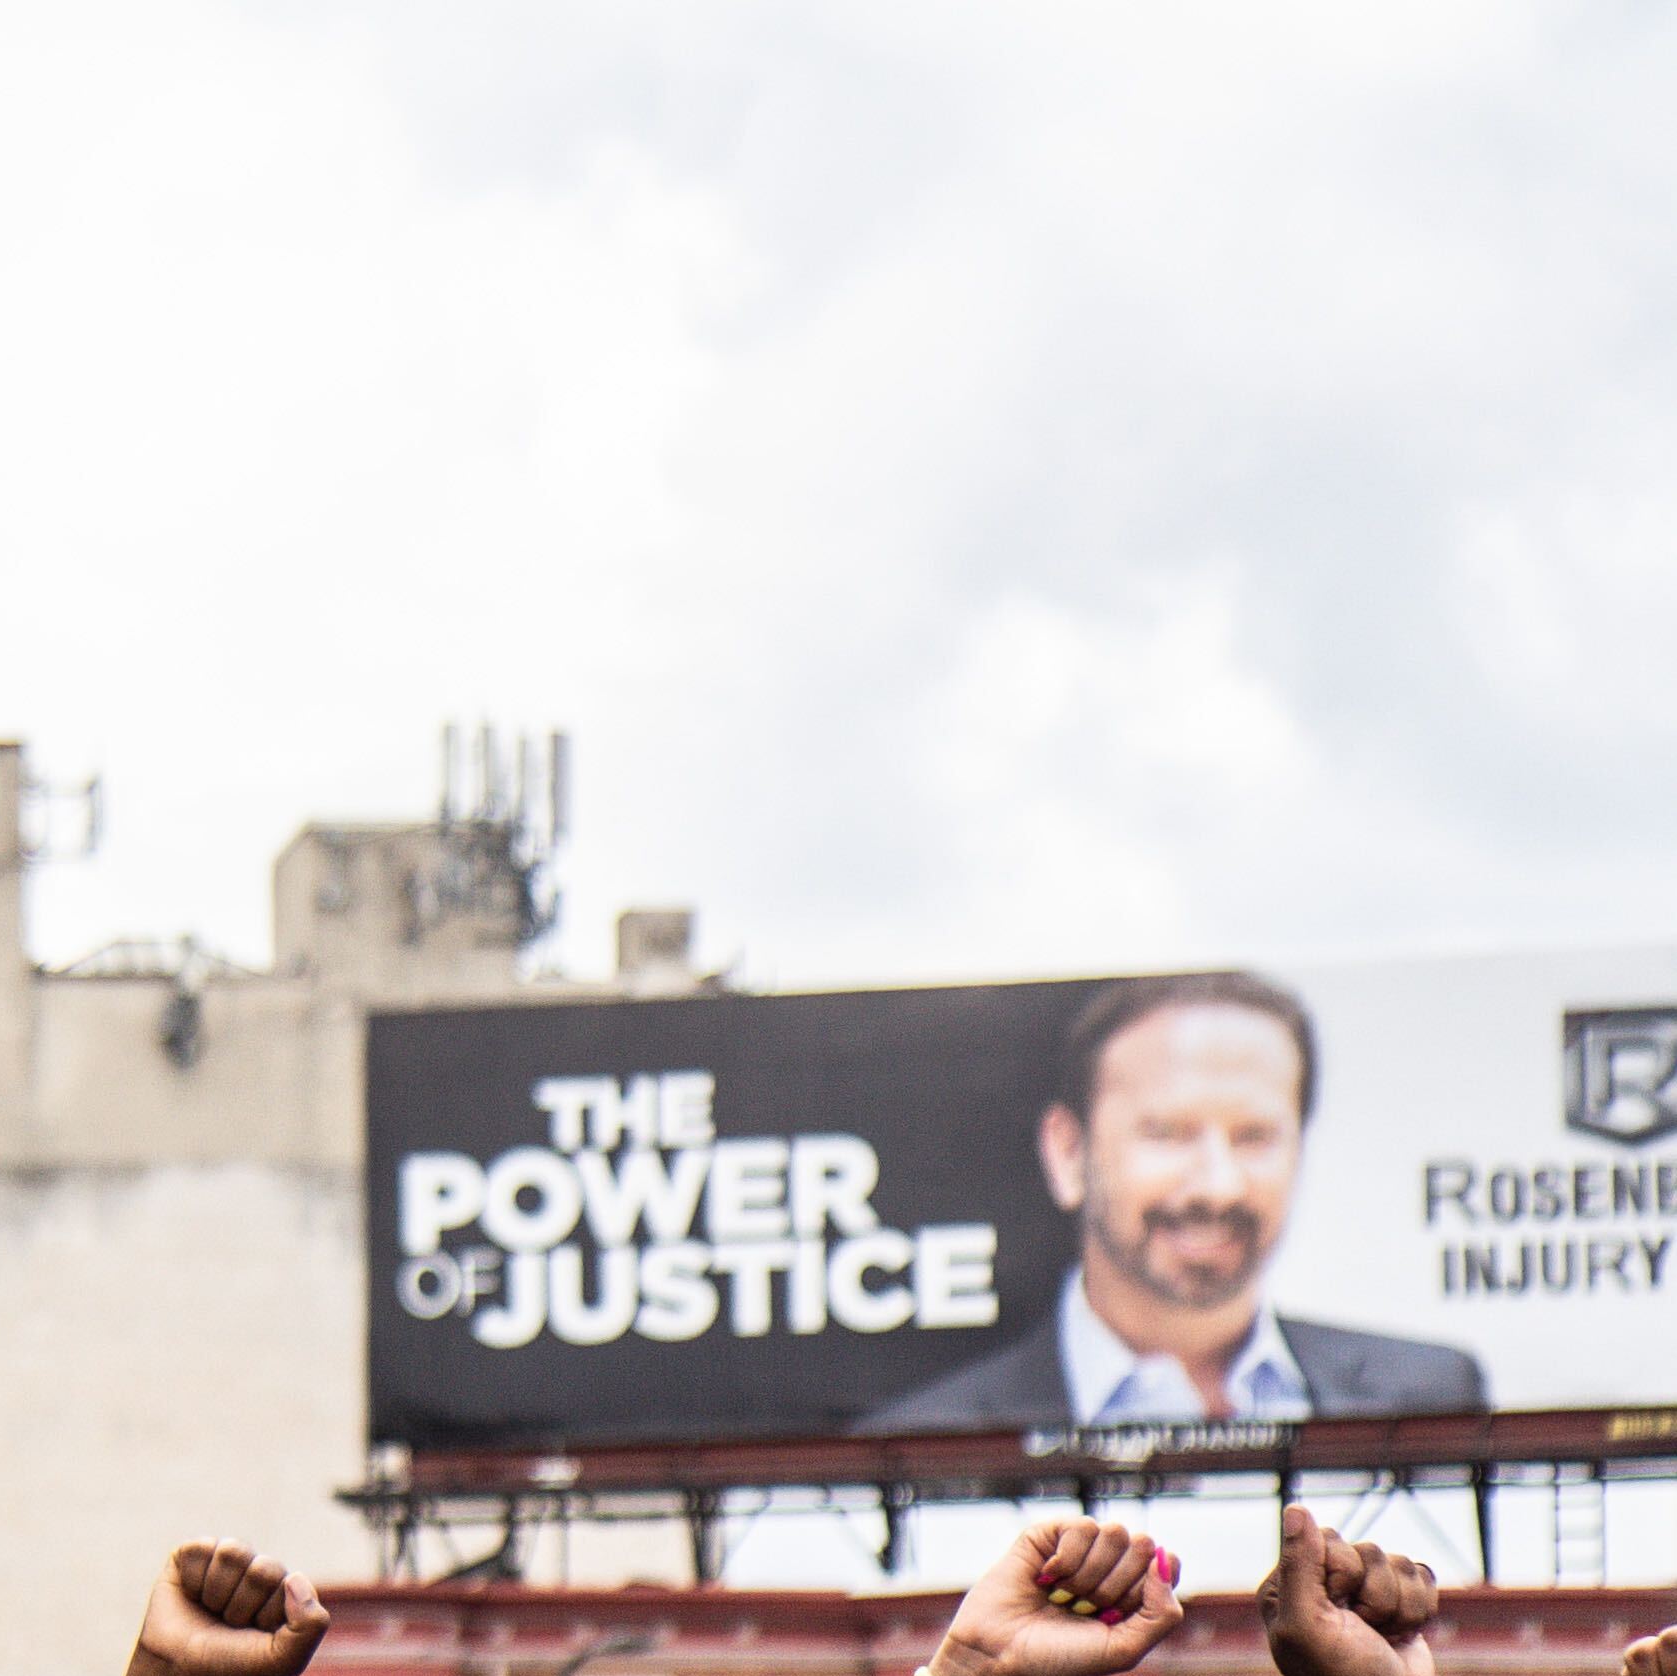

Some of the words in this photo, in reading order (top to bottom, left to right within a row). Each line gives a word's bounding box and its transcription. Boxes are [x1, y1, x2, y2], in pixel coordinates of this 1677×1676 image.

[534, 1070, 715, 1152] THE
[397, 1132, 879, 1257] POWER
[395, 1247, 501, 1320] OF
[472, 1223, 999, 1350] JUSTICE
[1441, 1235, 1671, 1294] INJURY
